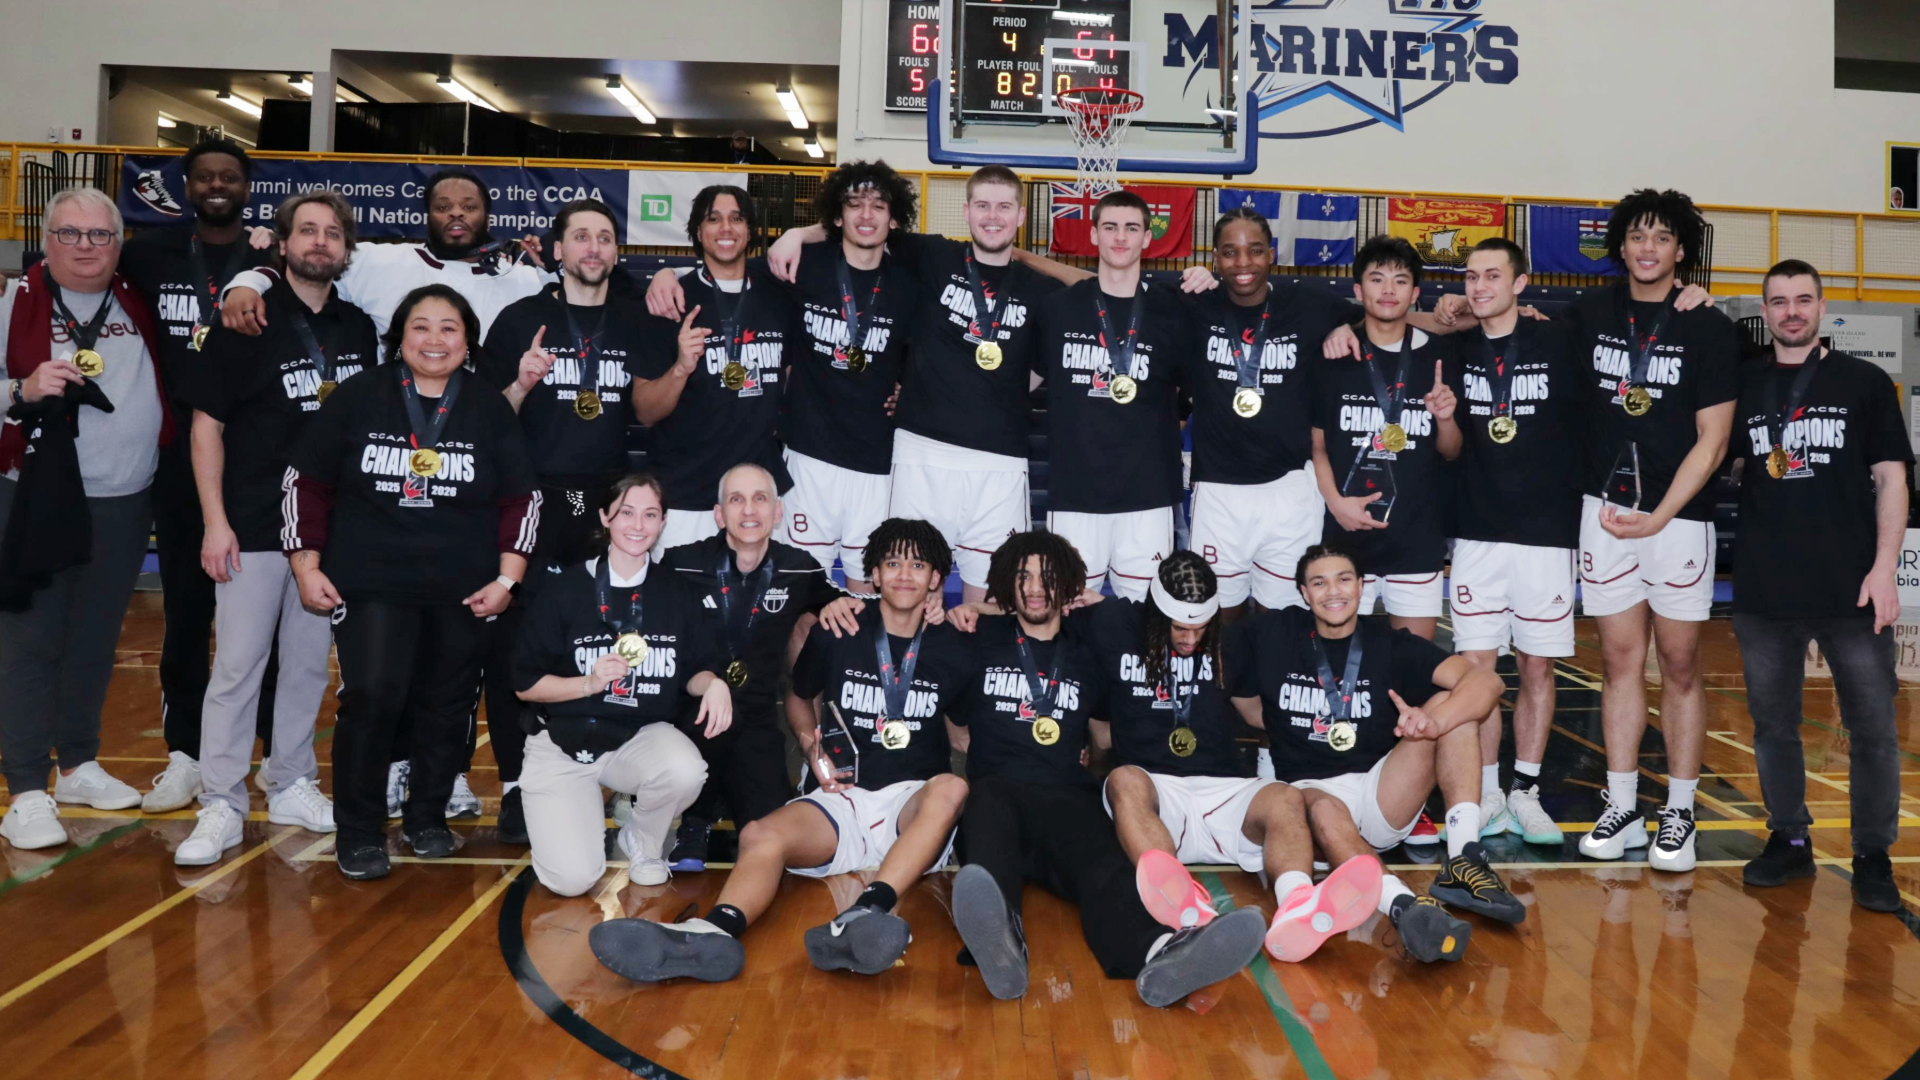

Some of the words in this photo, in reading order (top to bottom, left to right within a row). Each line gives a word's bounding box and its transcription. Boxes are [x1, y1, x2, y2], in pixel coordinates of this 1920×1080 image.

[907, 5, 939, 20] HOM
[993, 17, 1027, 28] PERIOD
[1003, 32, 1017, 52] 4
[899, 57, 930, 67] FOULS
[978, 60, 1014, 71] PLAYER
[1017, 62, 1042, 72] FOUL
[1088, 65, 1118, 75] FOULS
[910, 69, 925, 91] 5
[896, 97, 927, 107] SCORE
[990, 100, 1024, 111] MATCH
[250, 179, 291, 194] umni
[297, 179, 395, 197] welcomes
[506, 185, 537, 201] the
[543, 186, 604, 204] CCAA
[643, 199, 669, 217] TD
[370, 208, 428, 225] Nation
[804, 303, 838, 314] CCAA
[169, 326, 189, 336] 2025
[1064, 332, 1096, 340] CCAA
[1265, 333, 1298, 344] ACSC
[1598, 334, 1627, 345] CCAA
[814, 342, 833, 356] 2025
[280, 358, 314, 370] CCAA
[1071, 374, 1091, 384] 2025
[1217, 369, 1238, 381] 2025
[1262, 374, 1283, 383] 2026
[1599, 379, 1617, 390] 2025
[557, 390, 577, 400] 2025
[1470, 405, 1490, 415] 2025
[1514, 405, 1535, 415] 2026
[1807, 406, 1848, 414] ACSC
[368, 433, 406, 442] CCAA
[435, 441, 474, 449] ACSC
[375, 481, 400, 492] 2025
[431, 485, 457, 497] 2026
[793, 513, 808, 533] B
[1203, 544, 1218, 565] B
[1457, 585, 1472, 604] B
[573, 634, 613, 644] CCAA
[845, 669, 878, 680] CCAA
[637, 682, 660, 694] 2026
[995, 701, 1017, 712] 2025
[853, 716, 874, 729] 2025
[1291, 717, 1311, 728] 2025
